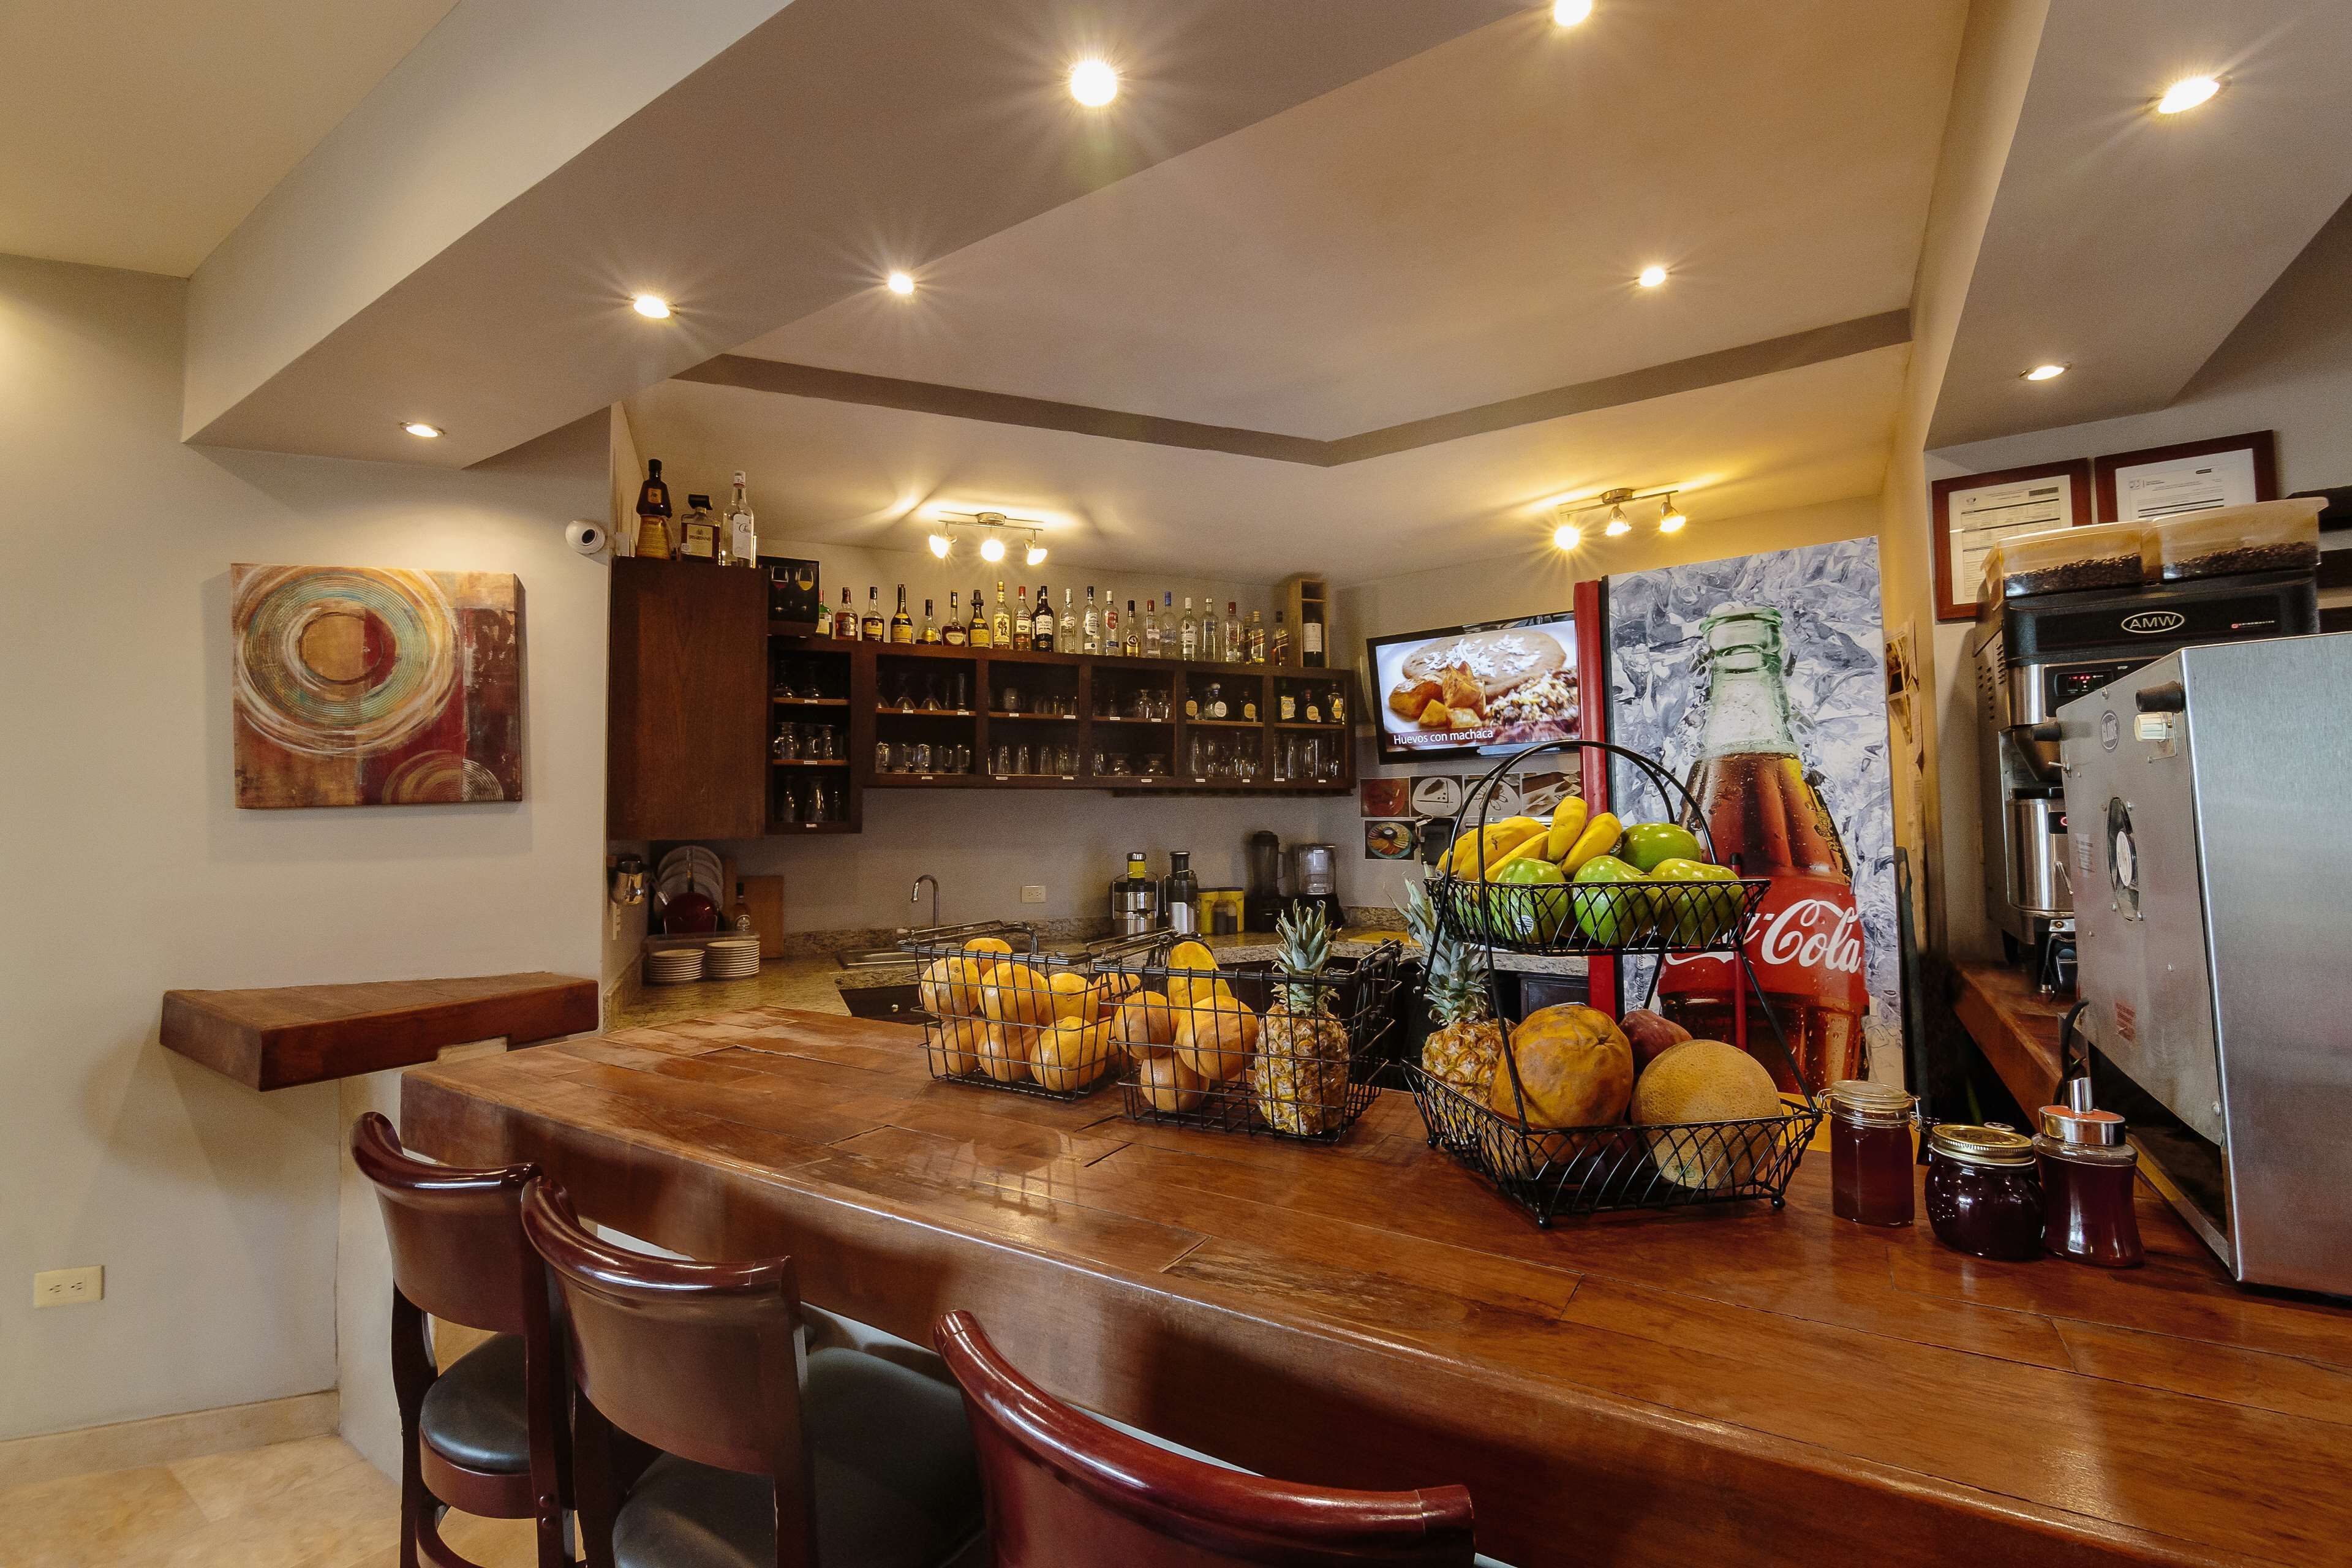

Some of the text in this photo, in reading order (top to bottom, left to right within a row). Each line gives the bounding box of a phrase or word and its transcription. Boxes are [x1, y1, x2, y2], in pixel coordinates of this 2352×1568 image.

[2129, 615, 2177, 630] AMW
[1393, 728, 1493, 745] Huevos con machaca
